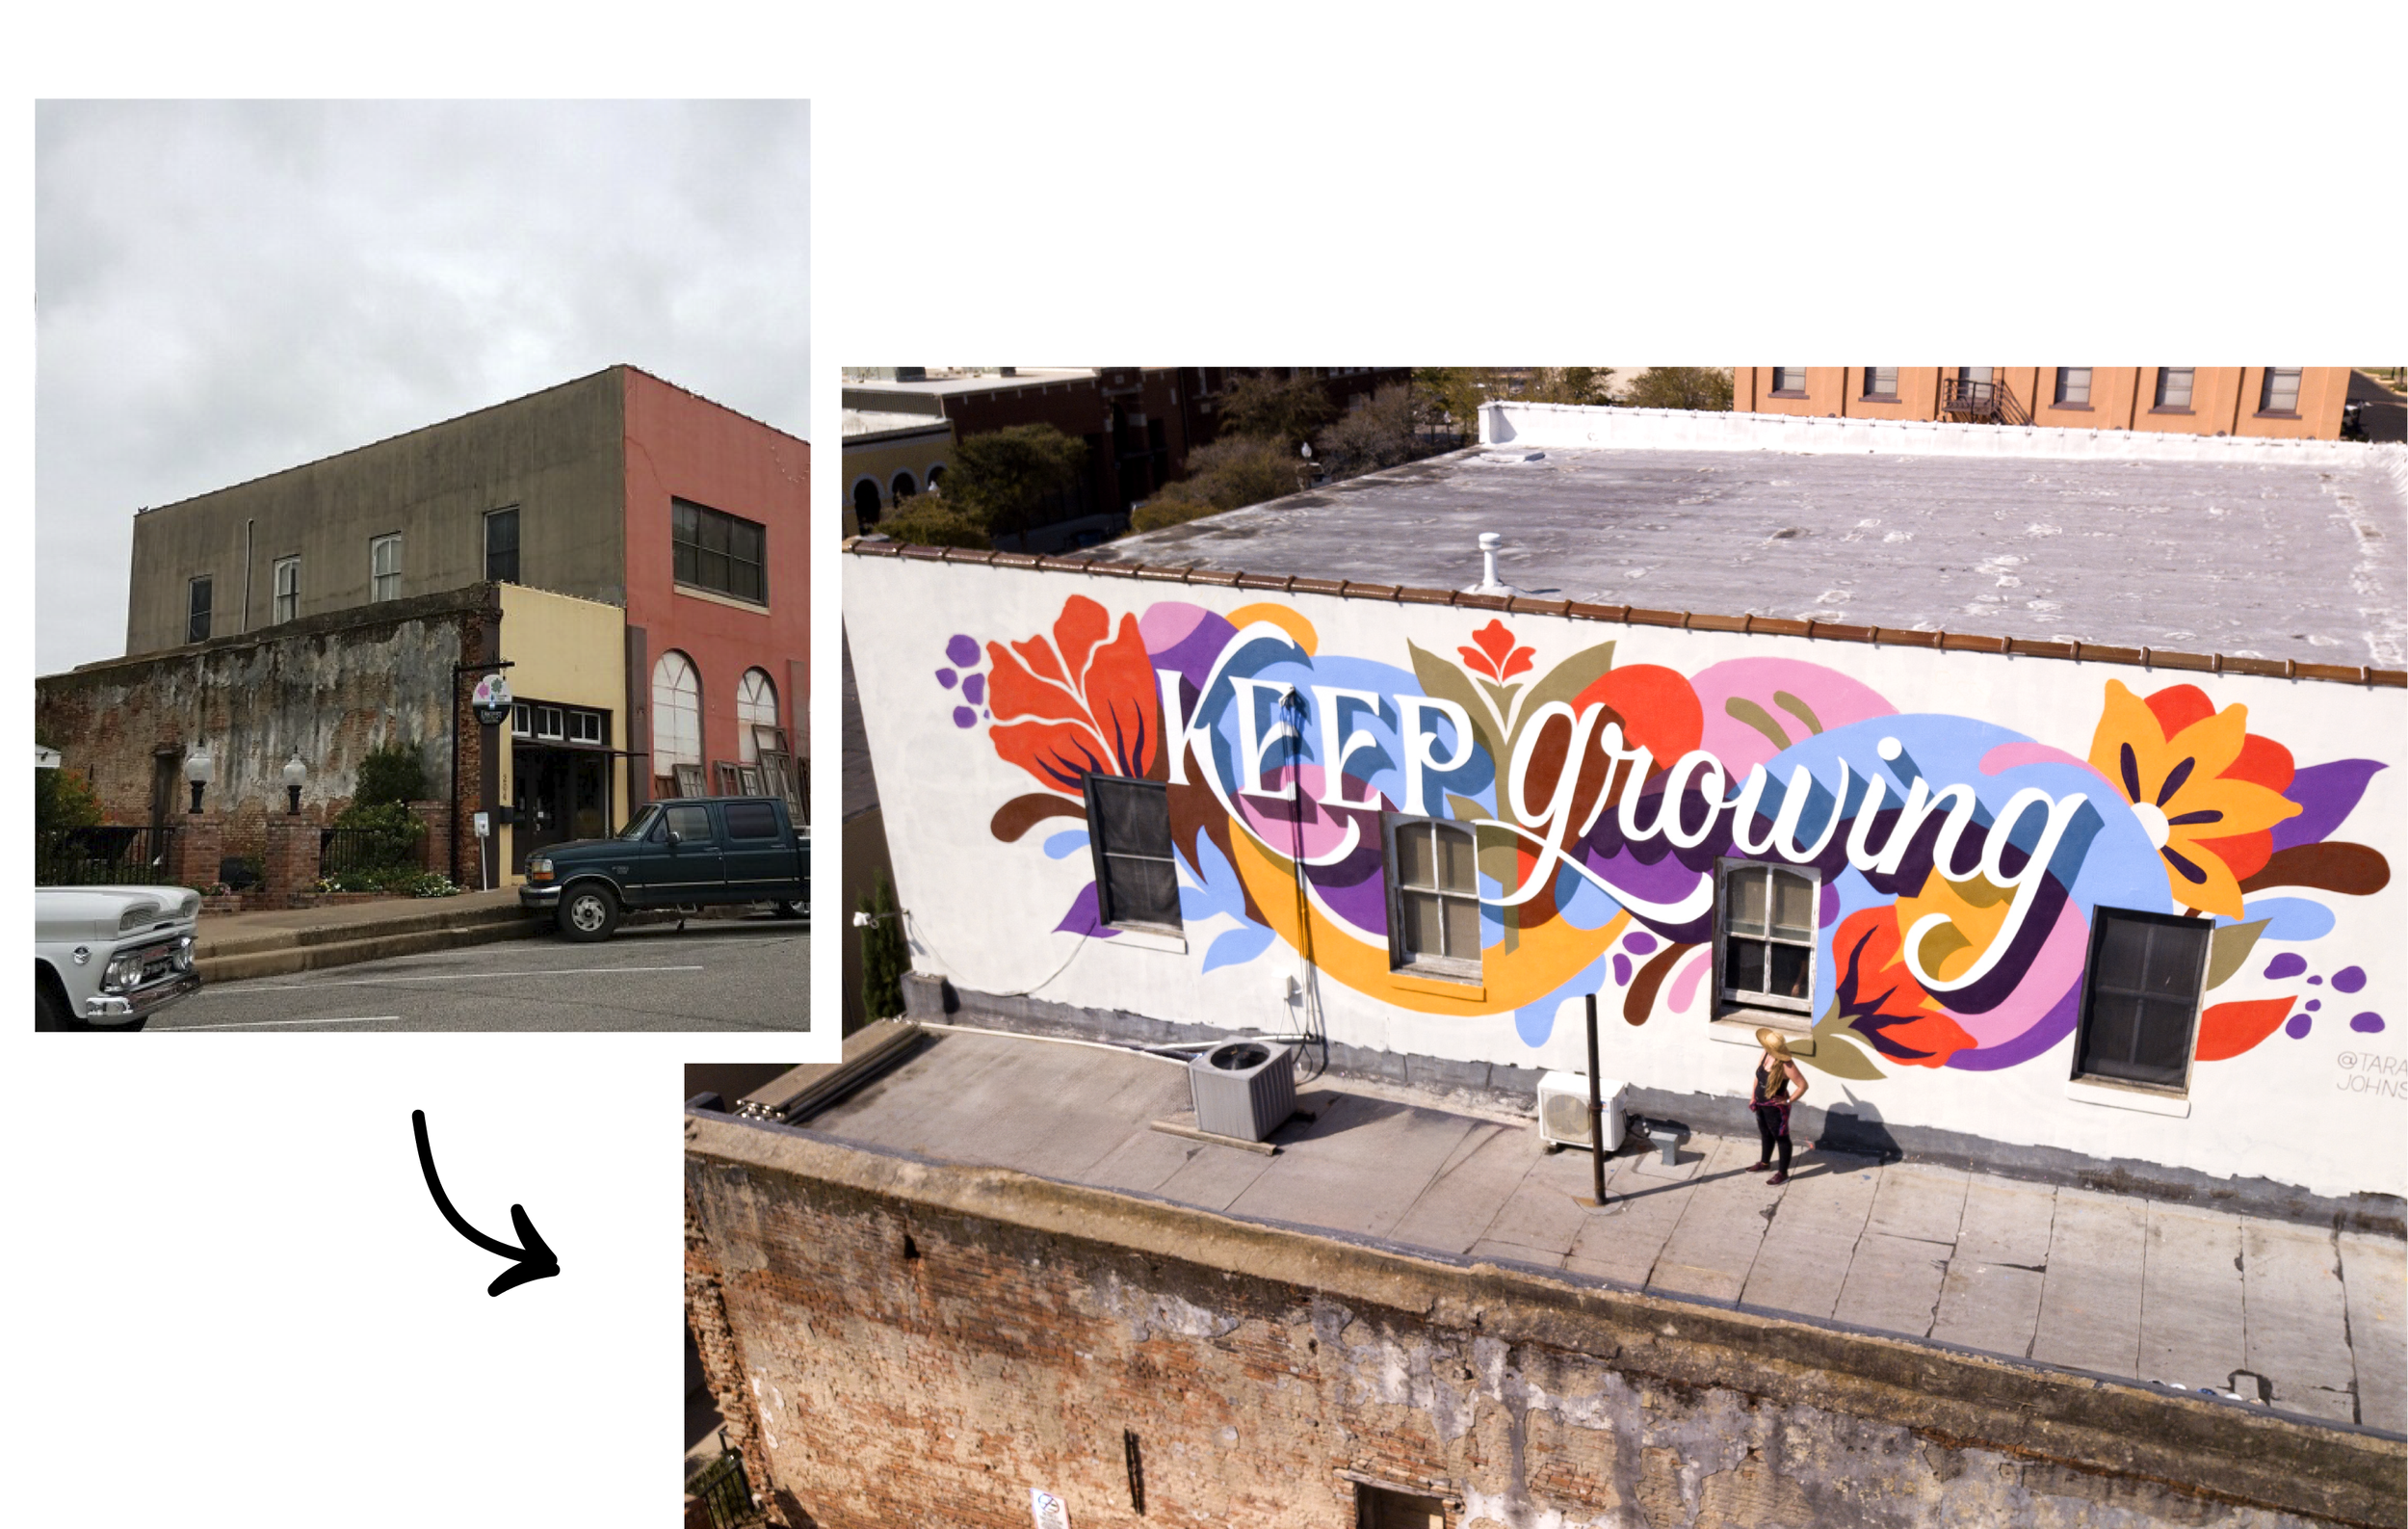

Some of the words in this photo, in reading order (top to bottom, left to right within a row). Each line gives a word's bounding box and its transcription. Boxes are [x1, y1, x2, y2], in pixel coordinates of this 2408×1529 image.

[1156, 620, 1475, 867] KEEP
[1472, 700, 2088, 991] growing
[2337, 1050, 2407, 1076] @TARA
